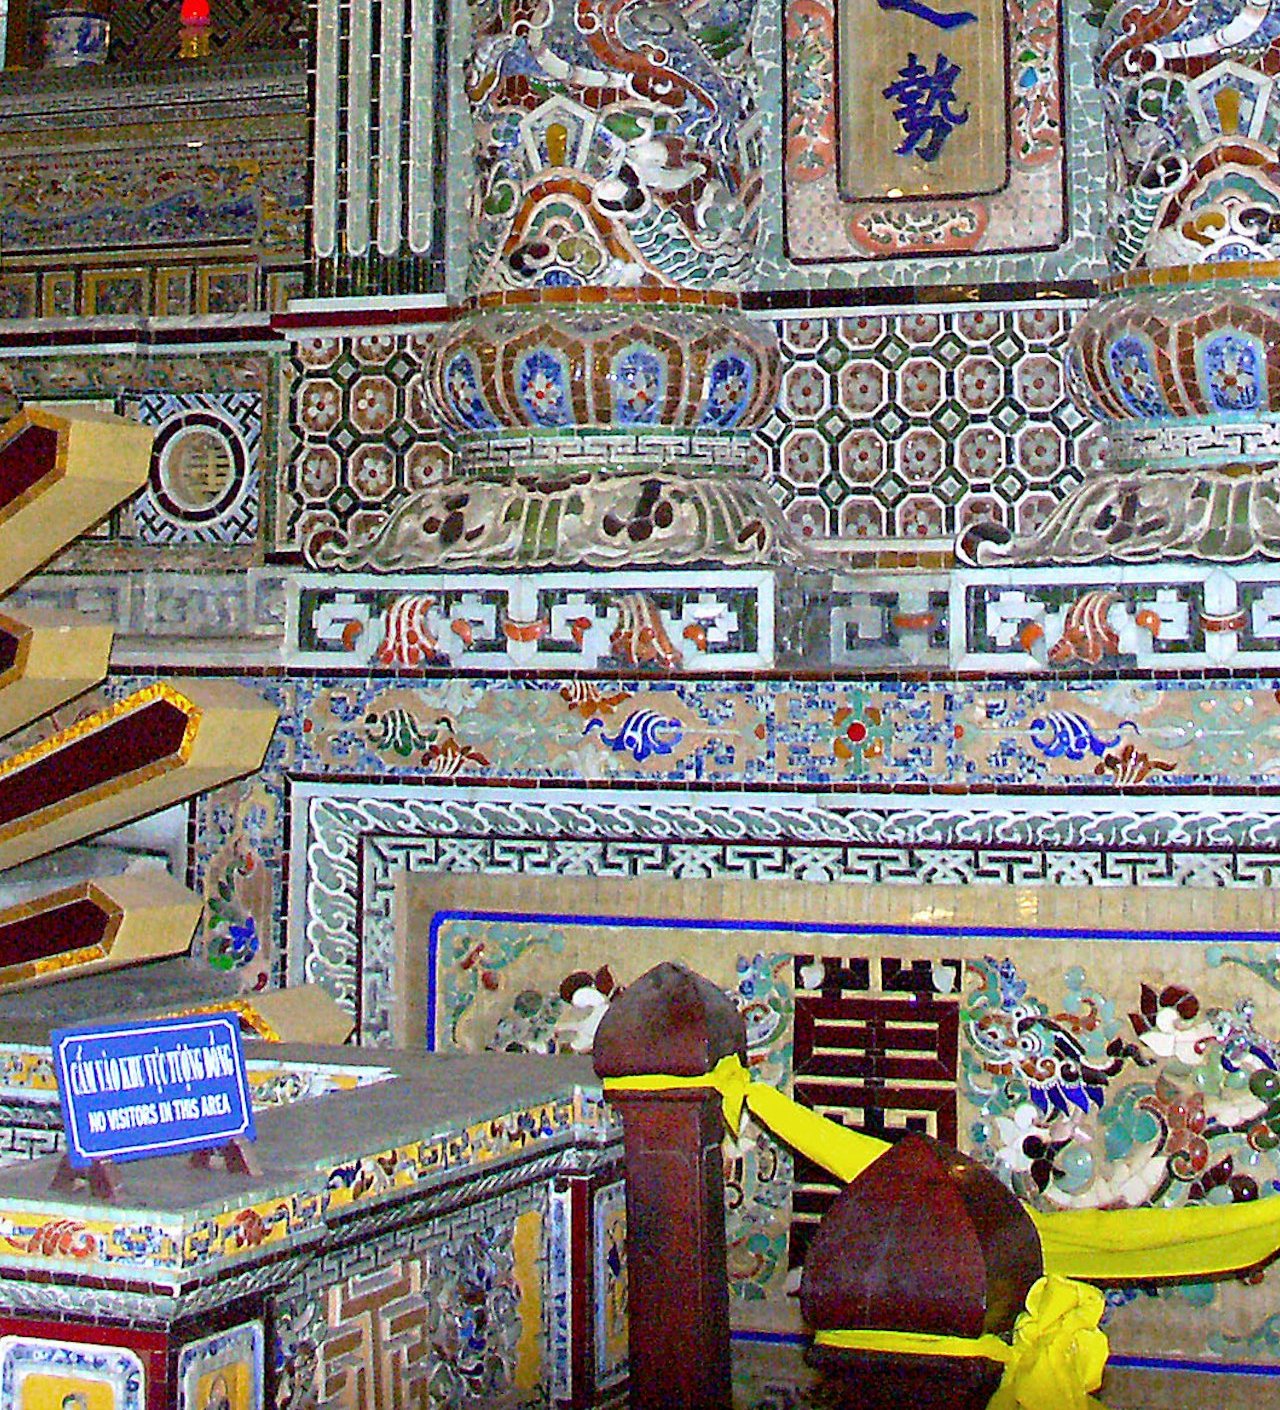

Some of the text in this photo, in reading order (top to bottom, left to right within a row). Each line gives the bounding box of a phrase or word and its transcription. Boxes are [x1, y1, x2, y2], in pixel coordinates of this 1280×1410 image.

[70, 1044, 97, 1095] CẤM
[94, 1050, 120, 1092] VÀO
[119, 1054, 145, 1090] KHU
[88, 1092, 232, 1134] NO VISITORS IN THIS AREA
